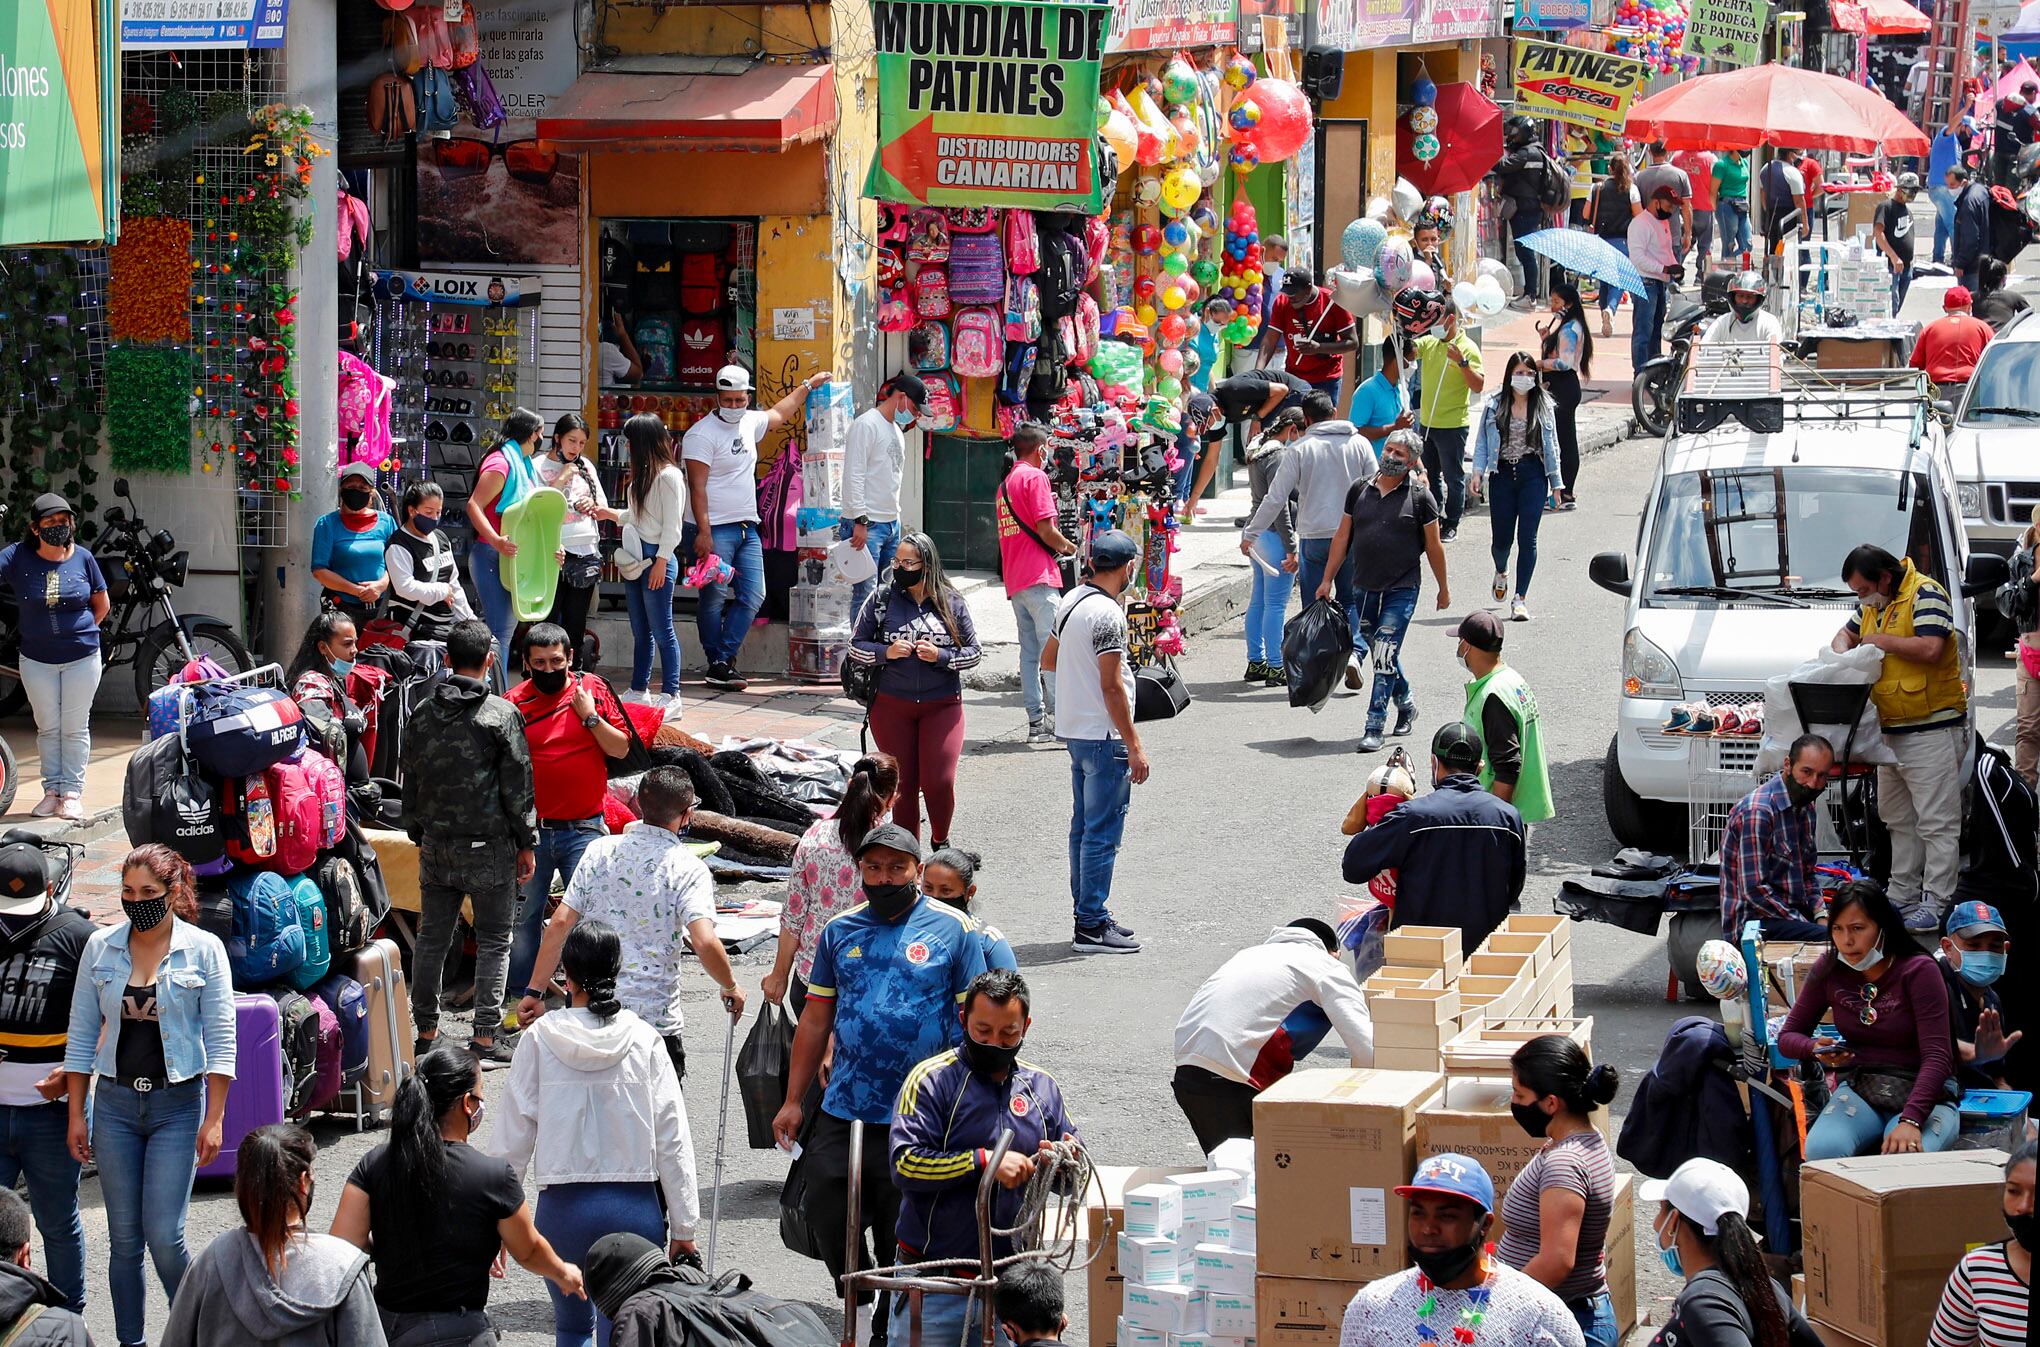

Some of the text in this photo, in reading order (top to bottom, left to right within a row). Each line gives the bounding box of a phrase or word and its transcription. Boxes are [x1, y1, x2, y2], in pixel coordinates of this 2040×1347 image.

[1540, 4, 1588, 16] BODEGA 215
[1708, 0, 1752, 12] OFERTA
[485, 12, 495, 20] es
[498, 8, 549, 22] fascinante,
[1699, 8, 1756, 28] Y BODEGA
[490, 32, 506, 42] que
[509, 28, 544, 40] mirarla
[874, 2, 1047, 59] MUNDIAL
[1058, 8, 1104, 60] DE
[1691, 22, 1759, 44] DE PATINES
[488, 47, 500, 60] de
[503, 47, 516, 60] las
[518, 47, 544, 62] gafas
[1520, 44, 1638, 88] PATINES
[909, 60, 1064, 118] PATINES
[1542, 84, 1614, 107] BODEGA
[938, 137, 1080, 162] DISTRIBUIDORES
[937, 159, 1078, 190] CANARIAN
[434, 280, 478, 296] LOIX
[682, 366, 713, 374] adidas
[890, 630, 952, 646] adidas
[272, 726, 298, 746] HILFIGER
[176, 824, 215, 837] adidas
[1454, 1144, 1517, 1156] 545x400x340
[1498, 1160, 1511, 1170] KG
